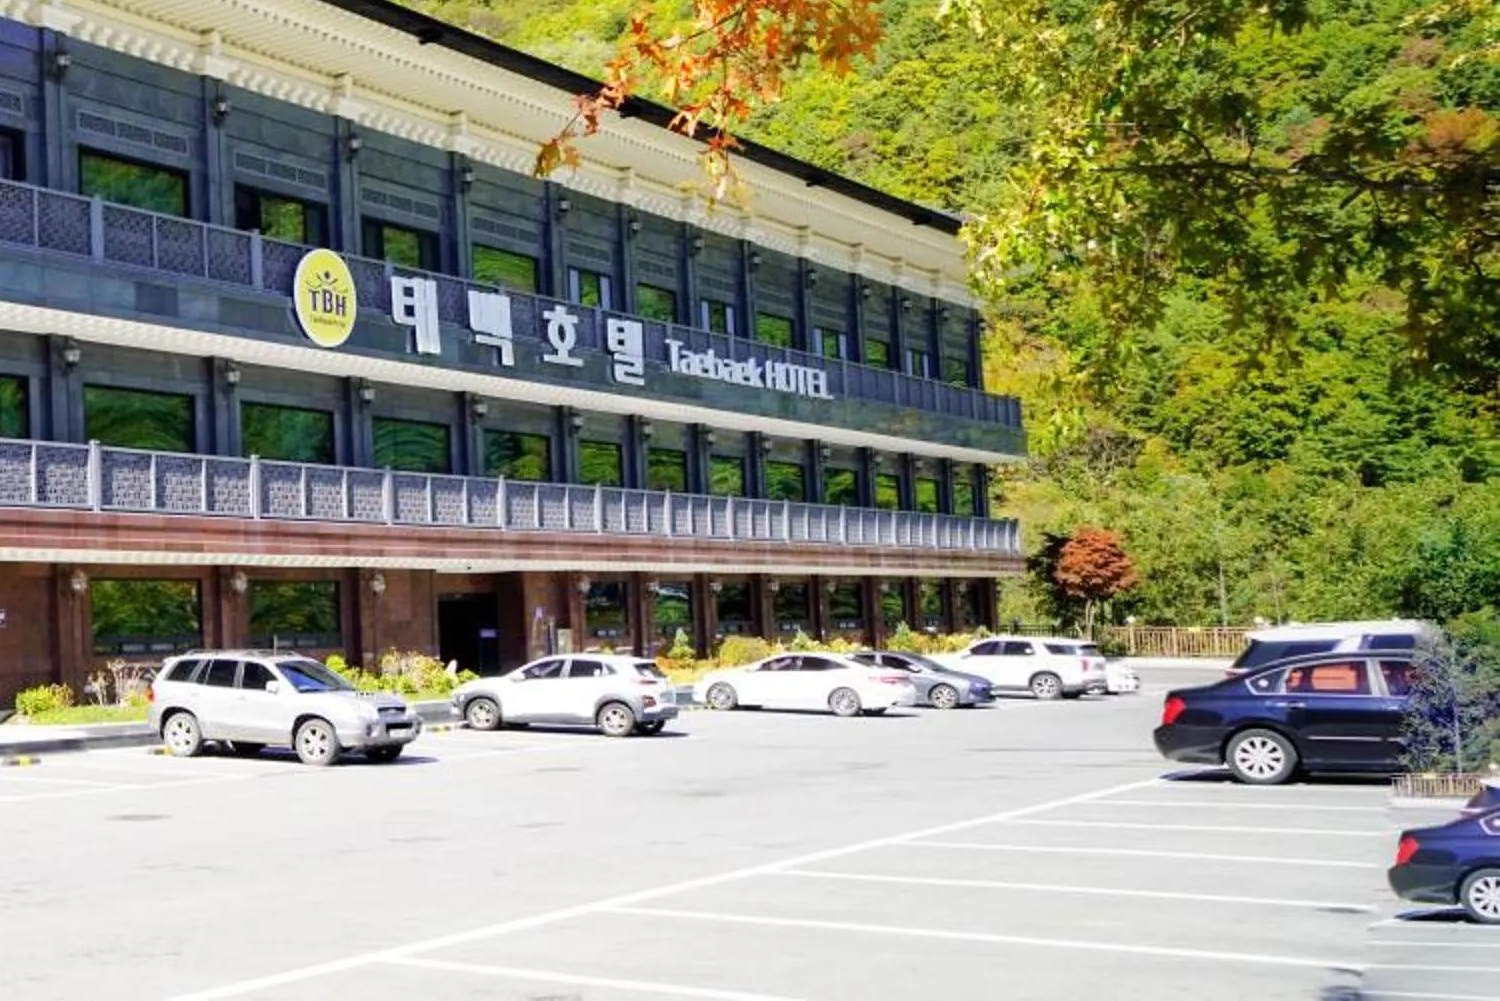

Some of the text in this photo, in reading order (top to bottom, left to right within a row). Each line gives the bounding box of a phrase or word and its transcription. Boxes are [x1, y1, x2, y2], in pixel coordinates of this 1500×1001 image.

[308, 288, 347, 317] TBH
[665, 338, 835, 399] Taebaek HOTEL
